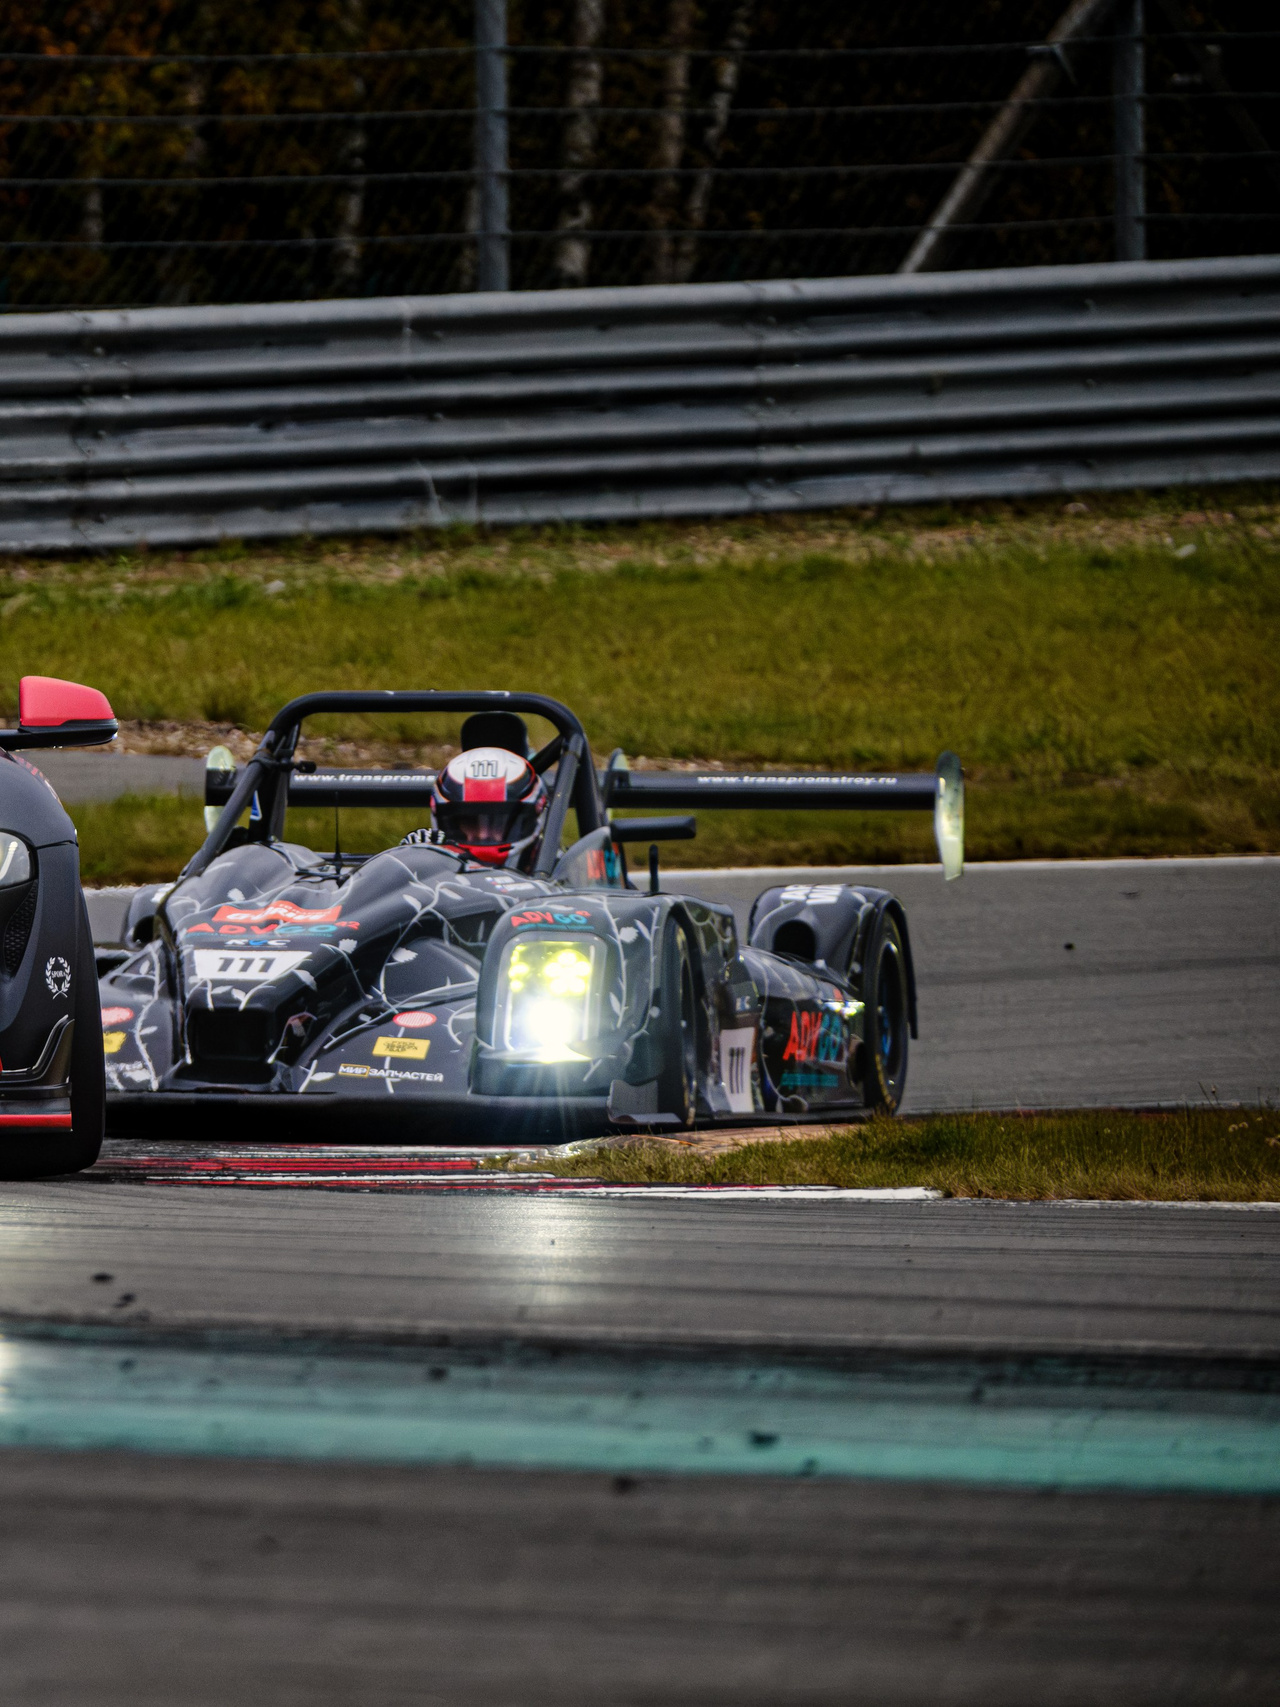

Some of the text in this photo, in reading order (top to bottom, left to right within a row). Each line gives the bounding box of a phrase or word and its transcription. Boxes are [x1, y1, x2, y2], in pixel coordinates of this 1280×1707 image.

[470, 760, 498, 777] 111
[697, 776, 898, 785] www.transpromstroy.ru
[217, 956, 276, 973] 111
[338, 1065, 444, 1082] МИР ЗАПЧАСТЕЙ
